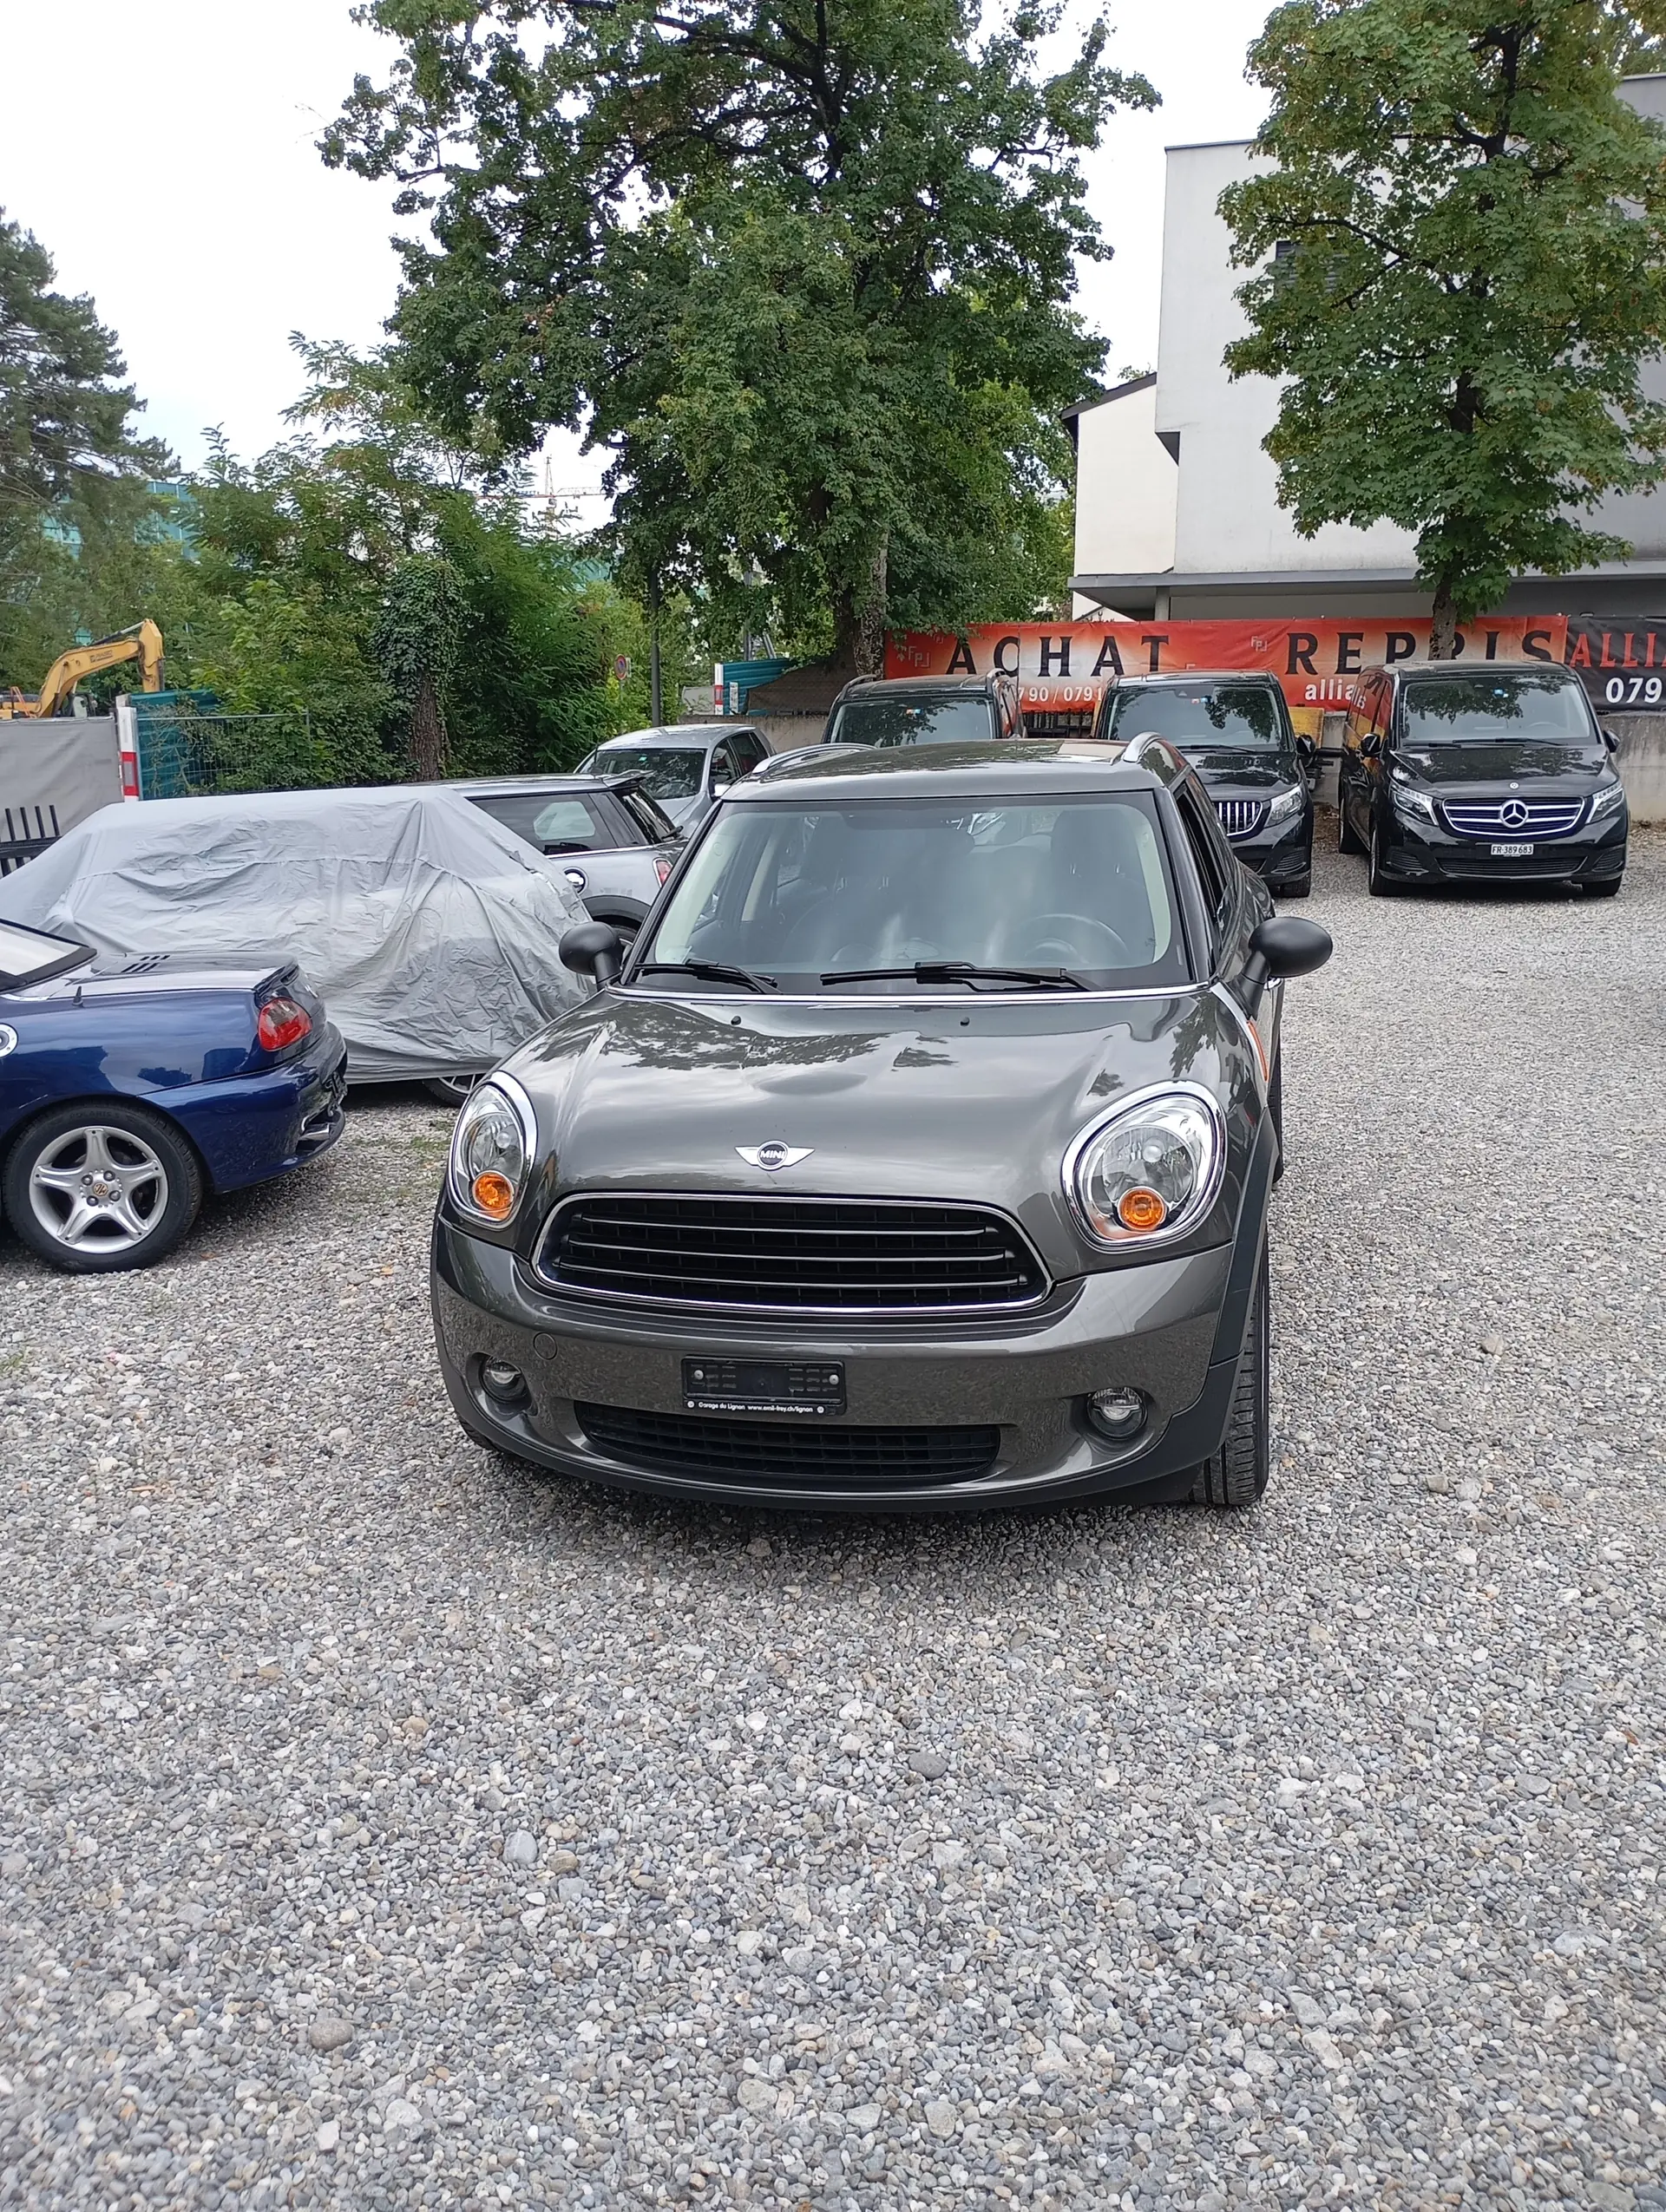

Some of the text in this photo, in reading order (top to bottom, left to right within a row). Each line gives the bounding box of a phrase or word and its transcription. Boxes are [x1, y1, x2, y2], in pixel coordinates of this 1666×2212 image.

[946, 635, 1169, 677] ACHAT
[1569, 632, 1666, 667] ALLI
[1605, 677, 1663, 704] 079
[760, 1149, 785, 1159] MINI
[699, 1401, 719, 1410] Garage
